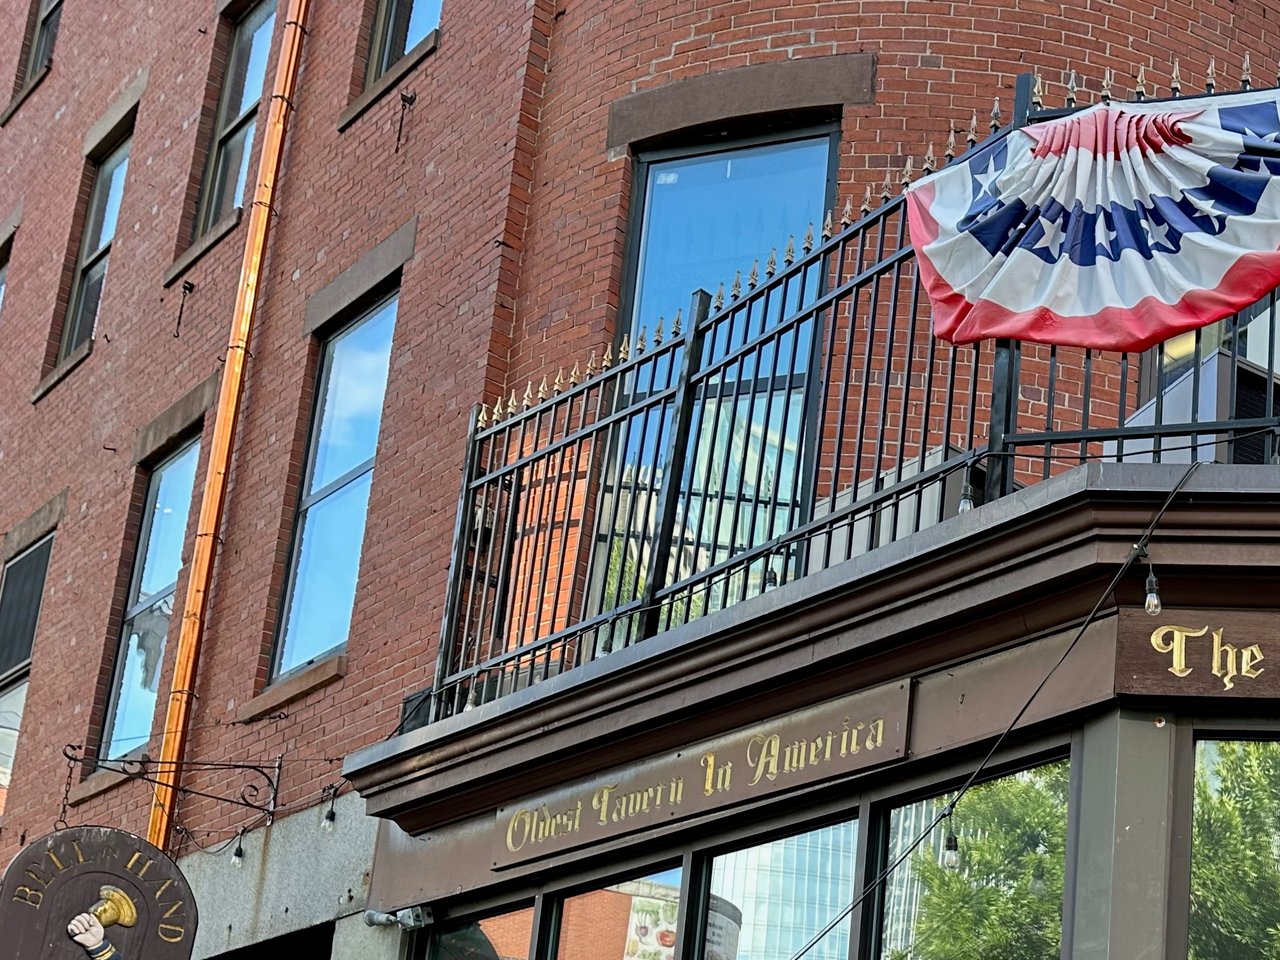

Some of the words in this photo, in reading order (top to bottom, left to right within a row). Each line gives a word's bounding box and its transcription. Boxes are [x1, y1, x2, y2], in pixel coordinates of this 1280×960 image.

[1150, 624, 1266, 691] The
[505, 801, 583, 852] Oldest
[592, 776, 685, 826] Tavern
[700, 751, 734, 797] In
[747, 715, 885, 786] America
[12, 840, 94, 911] BELL
[124, 848, 188, 943] HAND
